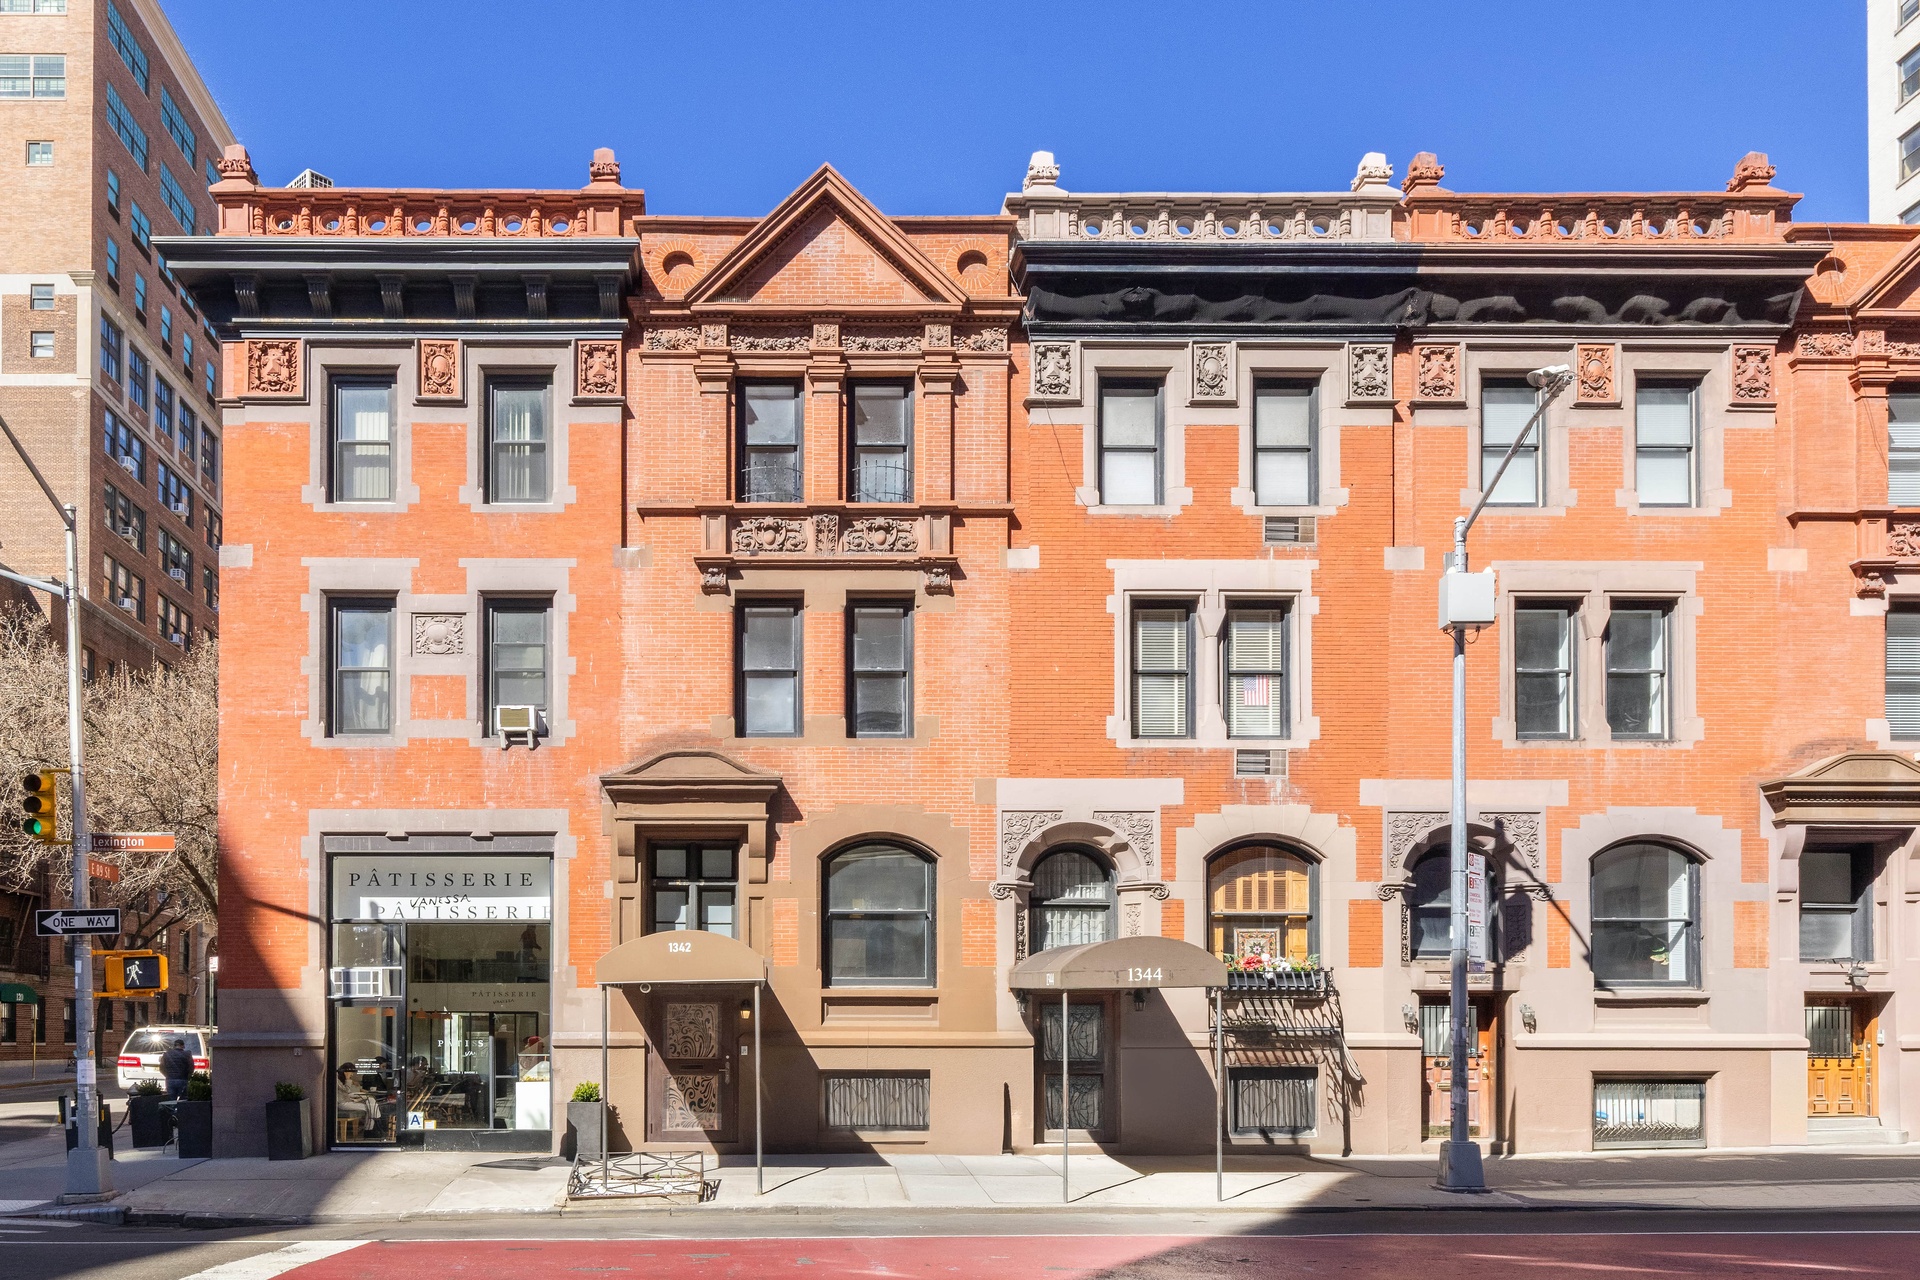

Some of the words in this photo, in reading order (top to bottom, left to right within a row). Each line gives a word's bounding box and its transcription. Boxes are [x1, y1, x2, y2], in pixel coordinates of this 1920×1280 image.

[93, 837, 144, 848] Lexington
[91, 863, 95, 875] E
[96, 864, 104, 877] 89
[104, 866, 111, 879] St
[348, 868, 533, 887] PÂTISSERIE
[409, 893, 471, 908] VANESSA
[52, 917, 75, 927] ONE
[86, 916, 110, 927] WAY
[668, 942, 692, 953] 1342
[1128, 967, 1163, 981] 1344
[410, 1114, 421, 1126] A
